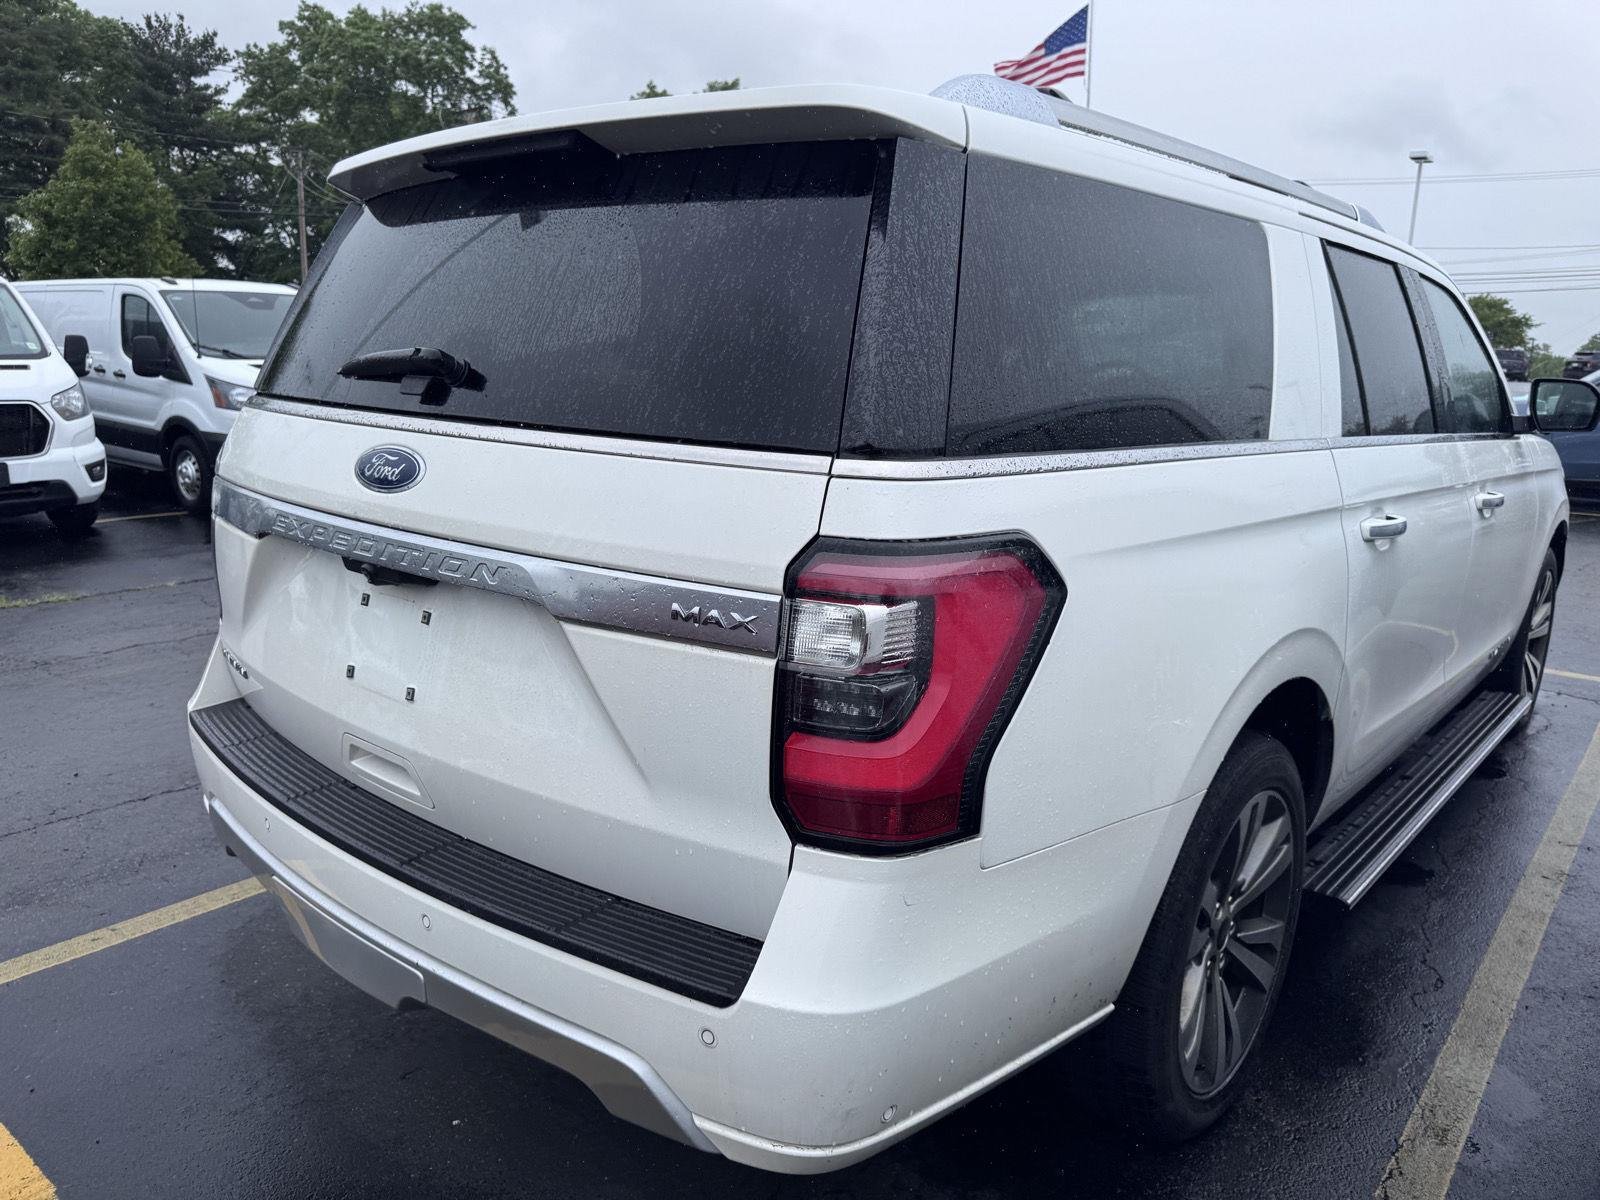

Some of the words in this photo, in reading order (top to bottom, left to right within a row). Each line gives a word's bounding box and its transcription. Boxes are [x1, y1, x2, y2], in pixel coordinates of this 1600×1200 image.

[364, 453, 406, 481] Ford
[272, 513, 508, 585] EXPEDITION
[671, 602, 759, 635] MAX
